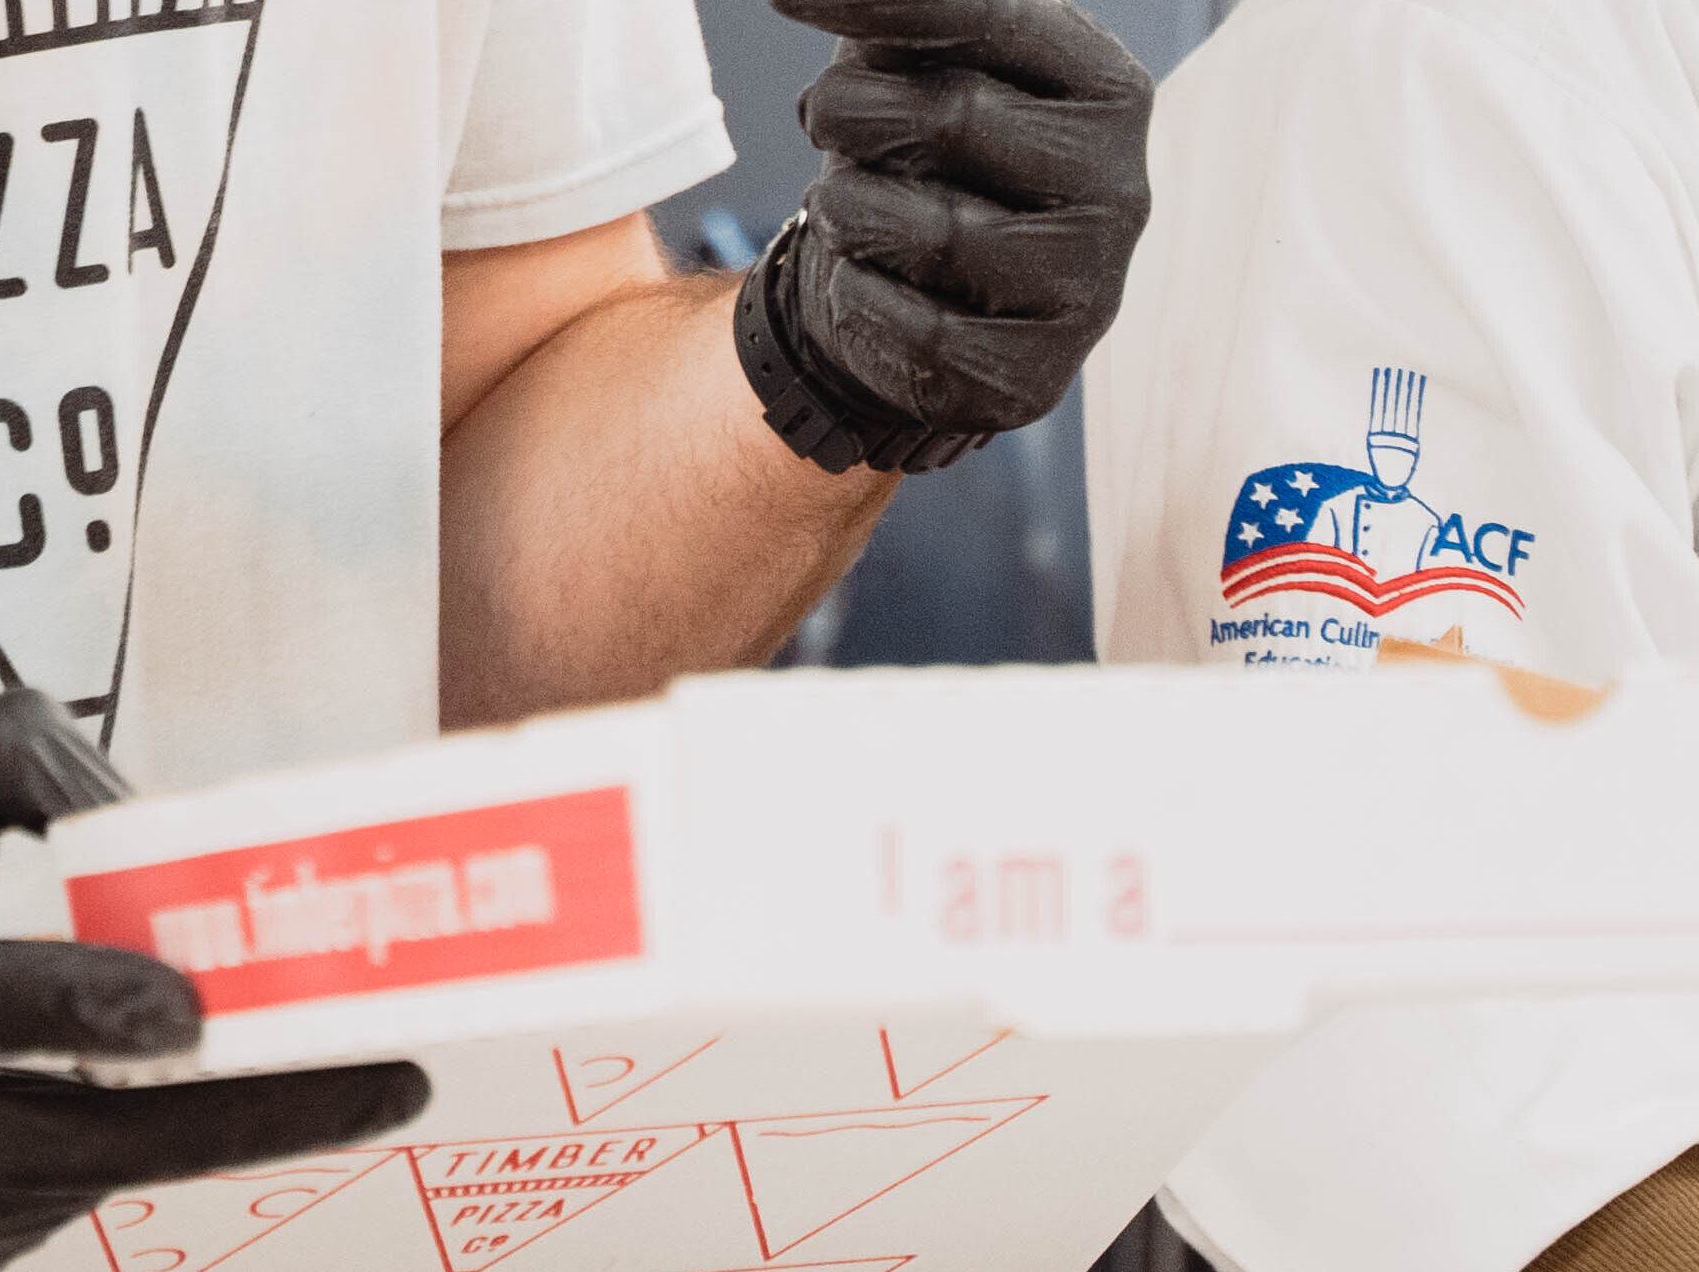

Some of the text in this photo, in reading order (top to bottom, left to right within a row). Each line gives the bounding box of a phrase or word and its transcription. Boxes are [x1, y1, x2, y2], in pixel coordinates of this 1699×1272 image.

[1429, 511, 1536, 577] ACF
[1210, 612, 1311, 647] American
[937, 848, 1069, 944] am
[1105, 848, 1152, 944] a
[445, 1137, 658, 1178] TIMBER
[450, 1197, 566, 1227] PIZZA
